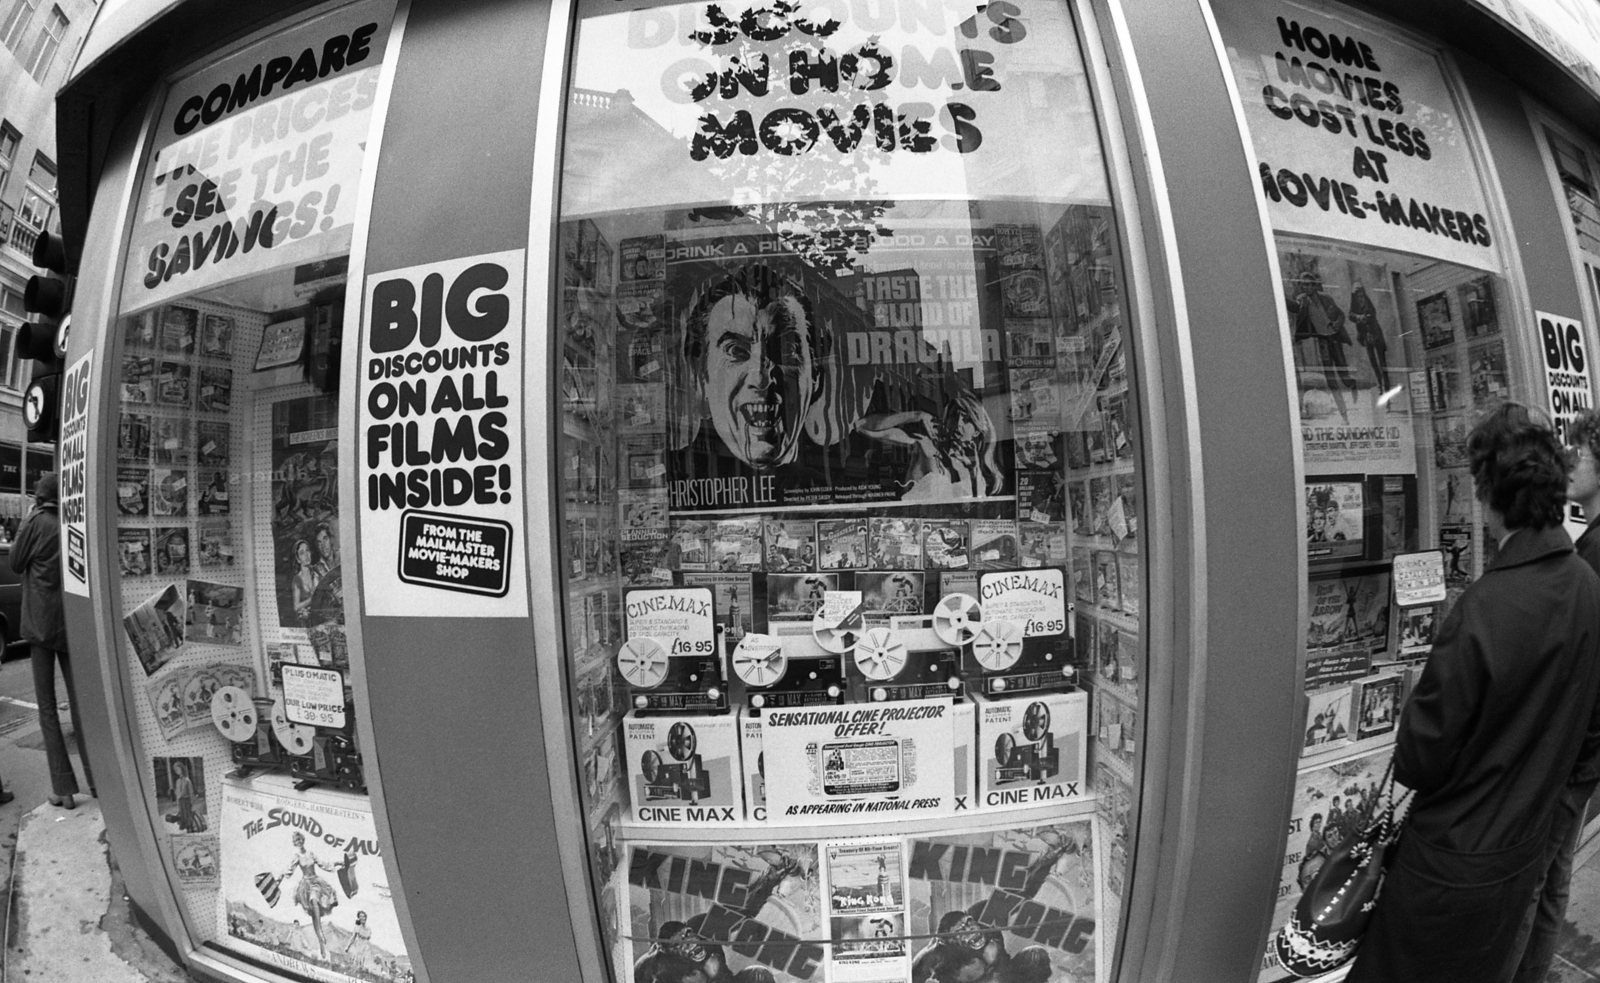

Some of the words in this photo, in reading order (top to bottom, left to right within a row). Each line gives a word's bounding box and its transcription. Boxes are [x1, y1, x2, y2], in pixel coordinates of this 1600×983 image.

[1277, 16, 1381, 72] HOME
[174, 22, 378, 136] COMPARE
[660, 53, 770, 103] ON
[788, 43, 1001, 96] HOME
[1275, 51, 1404, 115] MOVIES
[226, 70, 378, 160] PRICES
[690, 102, 982, 161] MOVIES
[1262, 84, 1357, 138] COST
[1361, 113, 1431, 161] LESS
[252, 132, 333, 201] THE
[1353, 146, 1389, 184] AT
[144, 183, 341, 289] SAVINGS!
[733, 242, 749, 255] A
[934, 235, 949, 246] A
[956, 235, 995, 246] DAY
[863, 275, 932, 301] TASTE
[936, 275, 977, 300] THE
[369, 262, 510, 354] BIG
[874, 302, 943, 328] BLOOD
[949, 302, 973, 327] OF
[369, 341, 510, 380] DISCOUNTS
[847, 329, 1002, 366] DRACULA
[1541, 318, 1585, 373] BIG
[64, 360, 90, 425] BIG
[368, 378, 427, 420] ON
[431, 370, 510, 414] ALL
[1549, 372, 1588, 389] DISCOUNTS
[1552, 389, 1571, 415] ON
[367, 411, 510, 469] FILMS
[1315, 427, 1335, 441] THE
[1336, 427, 1386, 441] SUNDANCE
[1386, 426, 1400, 440] KID
[62, 461, 84, 498] FILMS
[368, 463, 511, 511] INSIDE!
[752, 474, 776, 504] LEE
[416, 535, 495, 558] MAILMASTER
[422, 522, 457, 540] FROM
[458, 526, 482, 543] THE
[408, 548, 501, 571] MOVIE-MAKERS
[436, 564, 469, 580] SHOP
[982, 575, 1062, 599] CINEMAX
[627, 595, 711, 618] CINEMAX
[1311, 605, 1343, 617] ARROW
[285, 698, 300, 707] OUR
[302, 701, 317, 710] LOW
[318, 703, 343, 713] PRICE
[769, 711, 850, 726] SENSATIONAL
[851, 709, 879, 722] CINE
[880, 705, 945, 721] PROJECTOR
[835, 721, 886, 737] OFFER!
[786, 806, 799, 815] AS
[801, 802, 851, 814] APPEARING
[853, 802, 863, 812] IN
[865, 800, 910, 812] NATIONAL
[912, 798, 941, 809] PRESS
[986, 789, 1029, 806] CINE
[1034, 782, 1079, 801] MAX
[242, 818, 264, 839] THE
[266, 807, 323, 838] SOUND
[324, 834, 345, 848] OF
[638, 808, 682, 821] CINE
[687, 807, 735, 821] MAX
[628, 847, 753, 908] KING
[909, 839, 1034, 891] KING
[978, 888, 1096, 955] KONG
[698, 902, 823, 980] KONG
